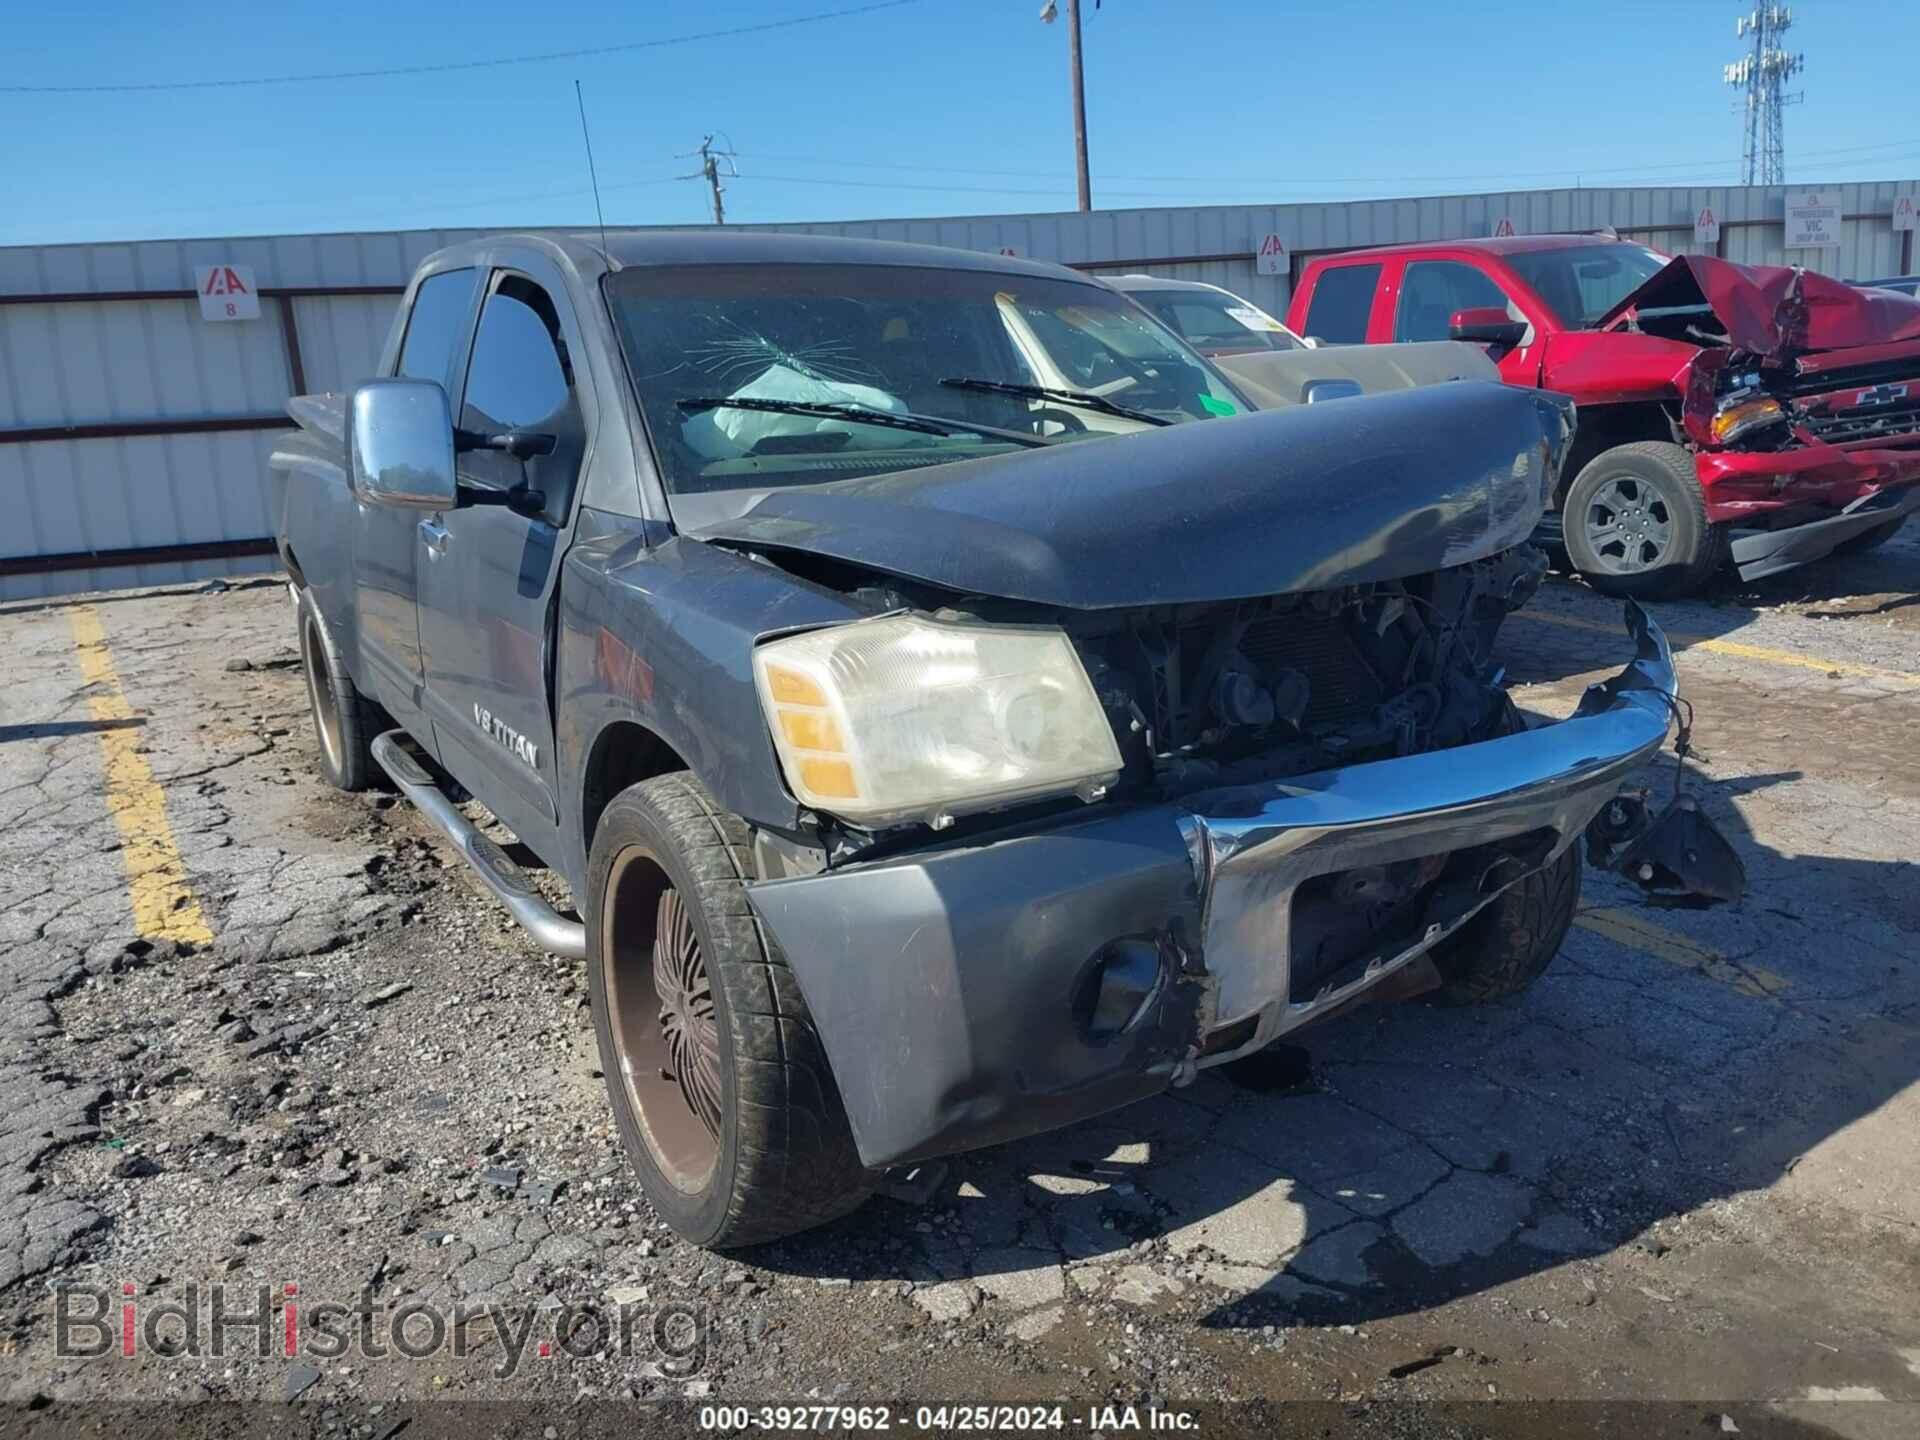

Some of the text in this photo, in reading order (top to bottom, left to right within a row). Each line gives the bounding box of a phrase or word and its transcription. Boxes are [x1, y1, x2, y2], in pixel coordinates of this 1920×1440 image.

[226, 303, 236, 317] 8
[474, 703, 538, 768] V8 TITAN
